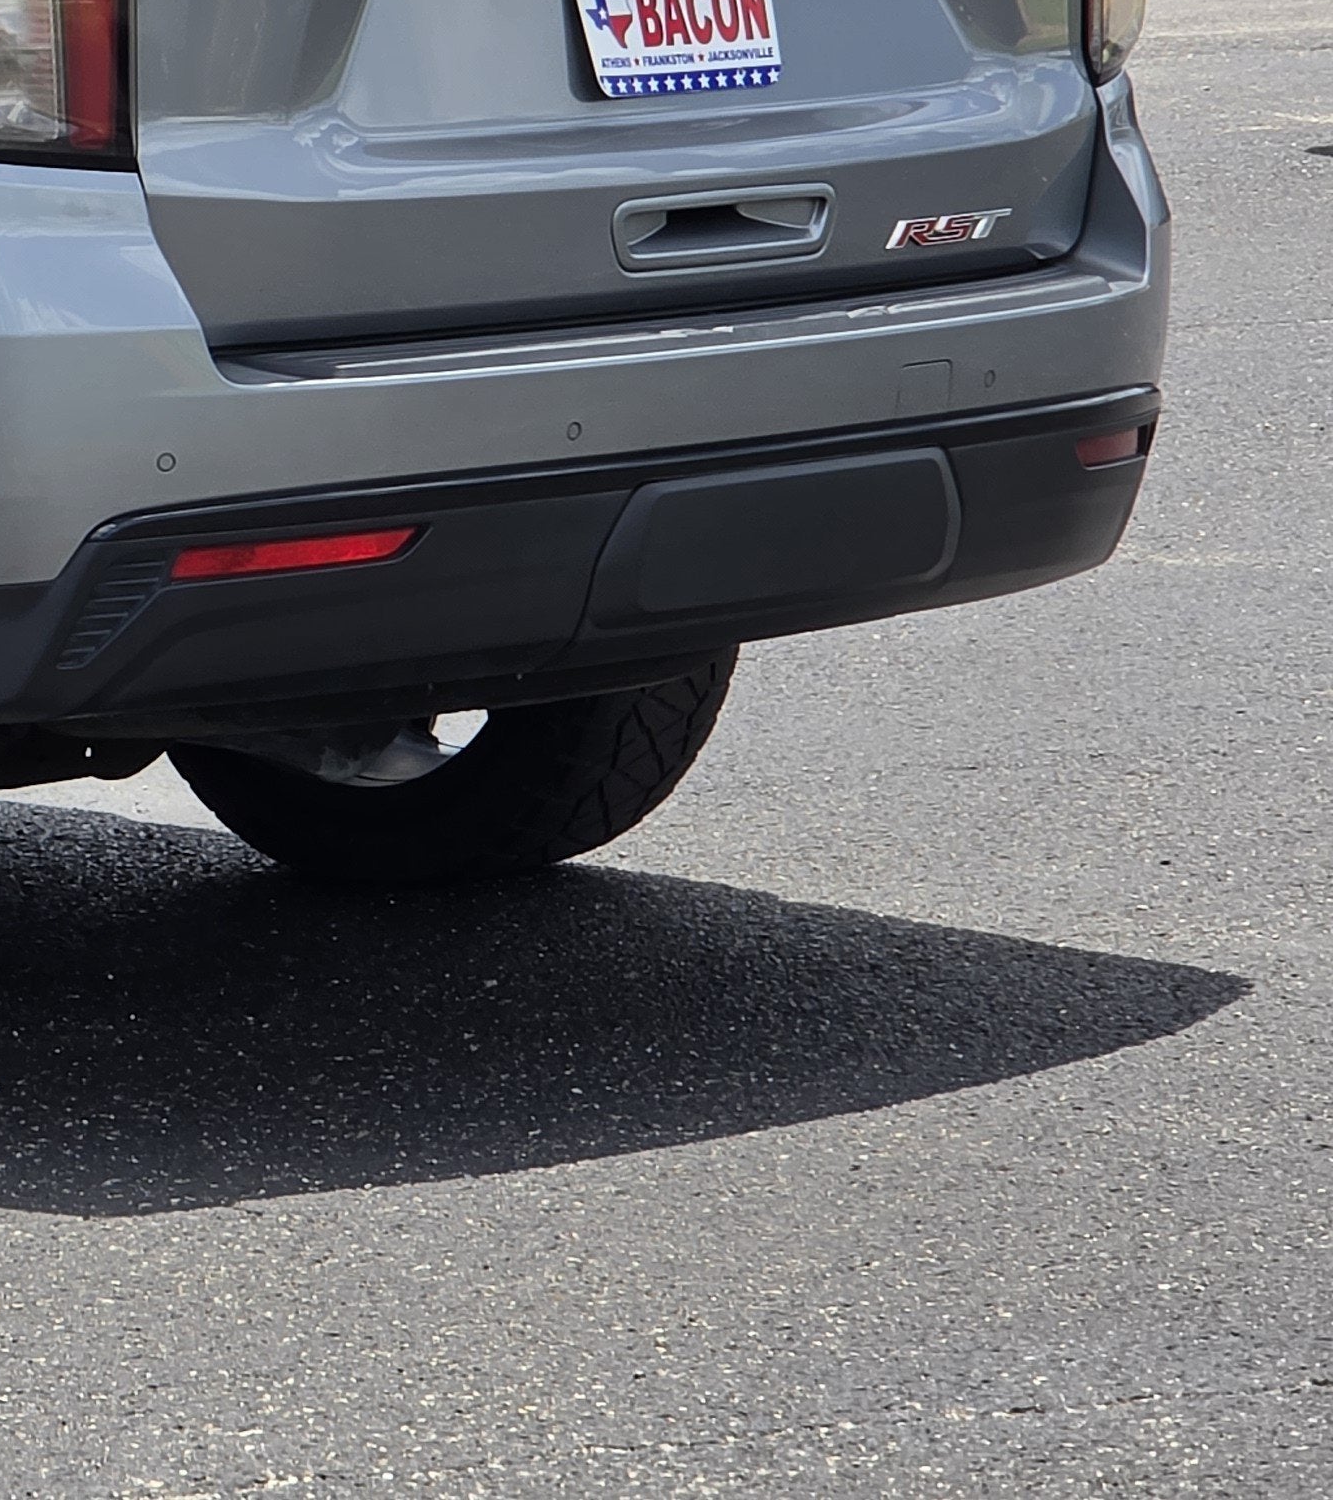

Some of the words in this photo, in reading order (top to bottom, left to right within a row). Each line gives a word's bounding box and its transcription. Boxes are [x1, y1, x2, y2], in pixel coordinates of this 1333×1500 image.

[601, 57, 631, 68] ATHENS
[642, 53, 695, 67] FRANKSTON
[707, 47, 774, 62] JACKSONVILLE
[885, 208, 1013, 250] RST
